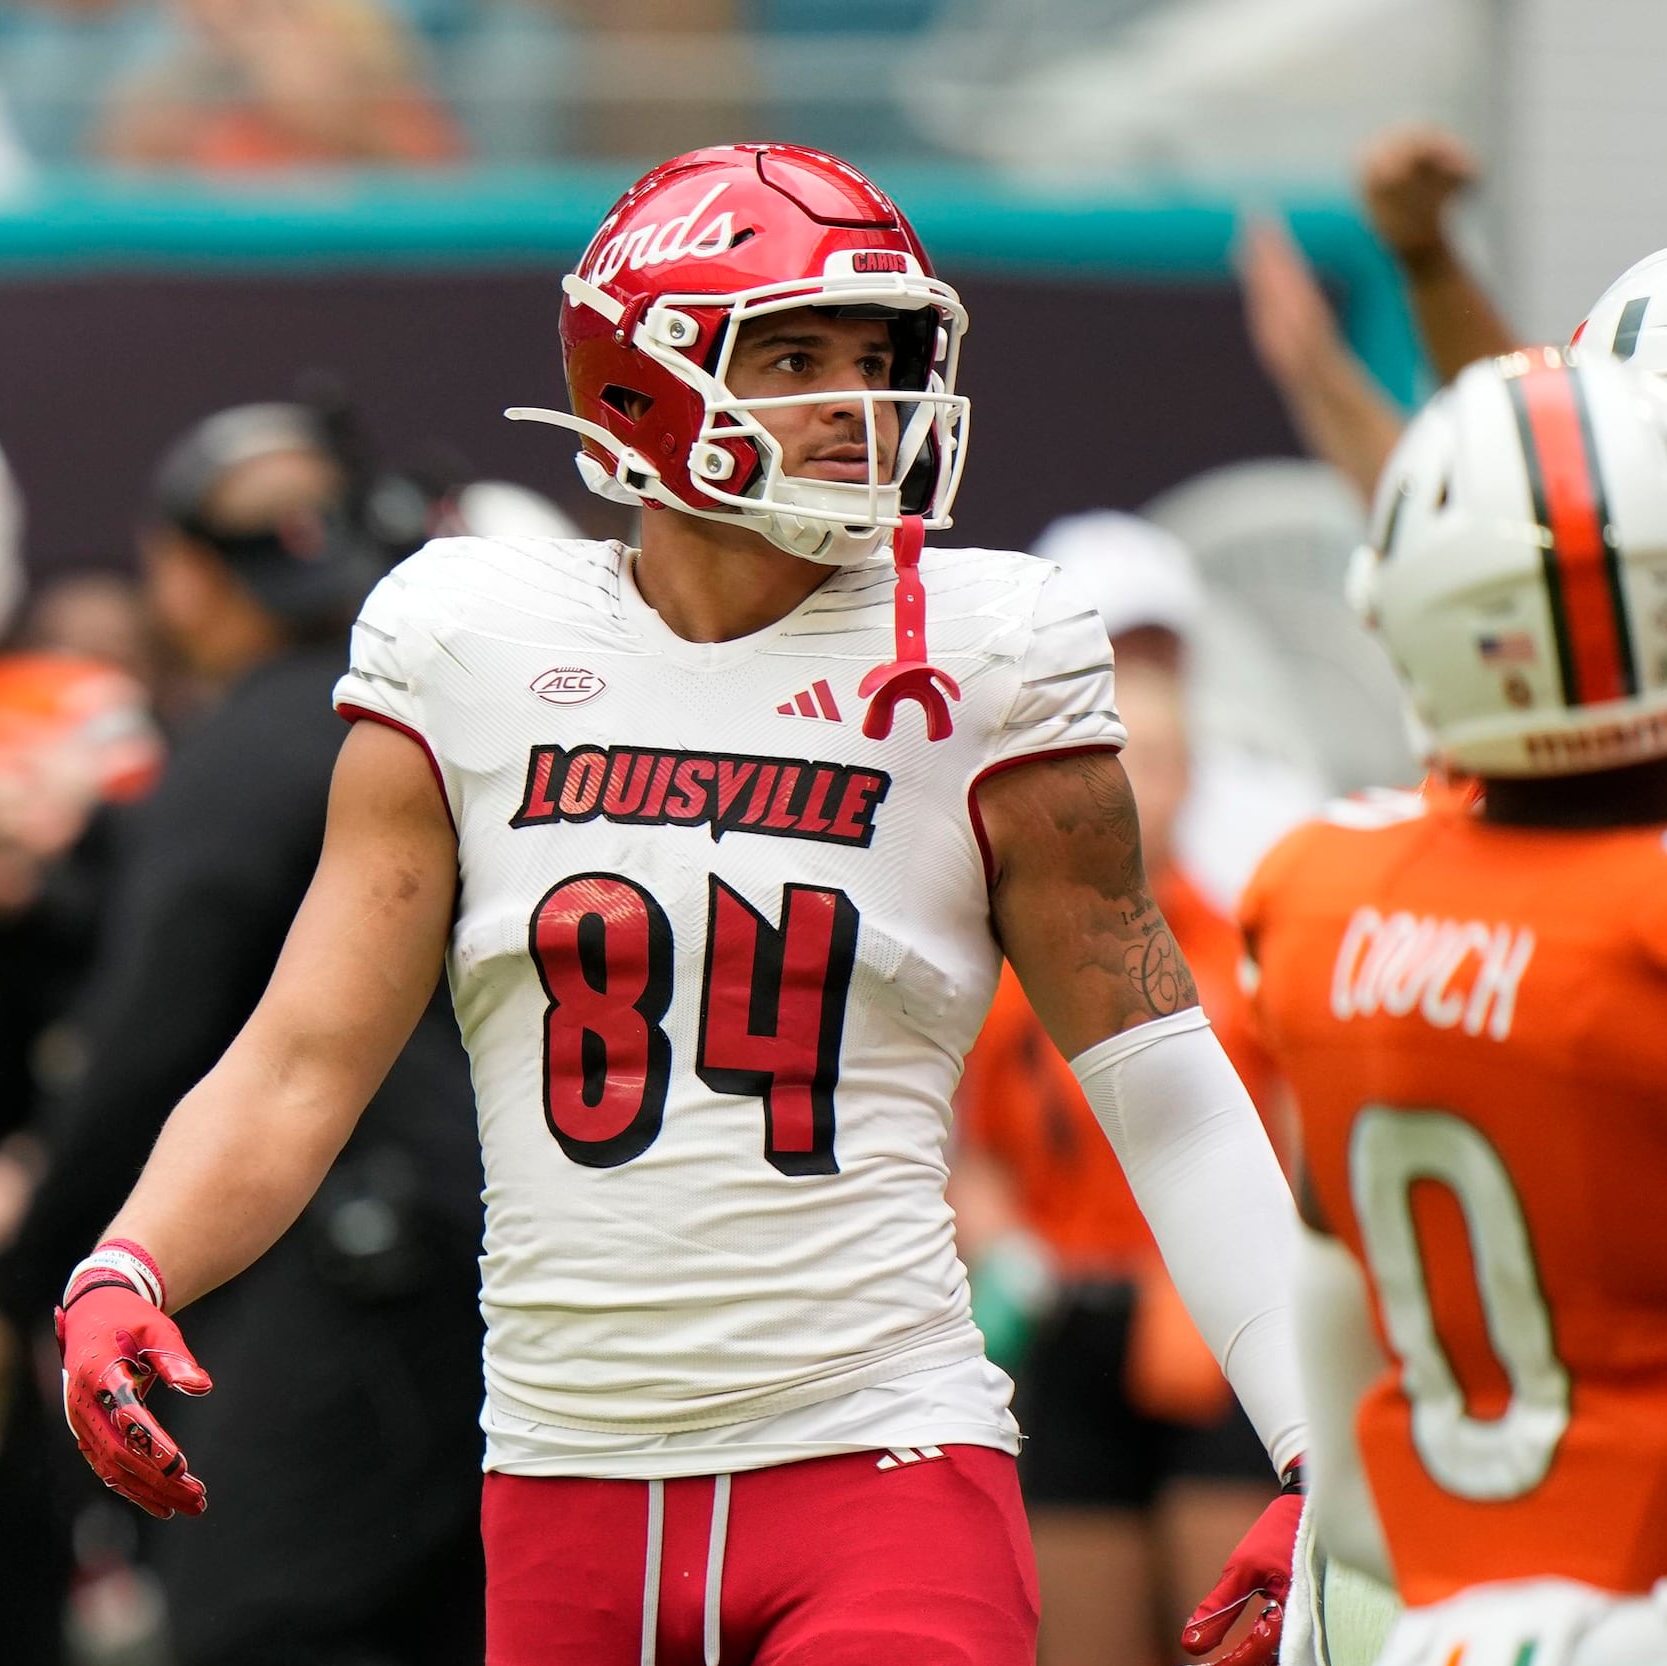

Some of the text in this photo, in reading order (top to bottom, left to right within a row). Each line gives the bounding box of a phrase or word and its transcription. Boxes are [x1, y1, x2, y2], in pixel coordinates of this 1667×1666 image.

[852, 252, 907, 273] CARDS
[539, 675, 593, 692] ACC
[509, 744, 892, 849] LOUISVILLE
[528, 871, 860, 1176] 84
[1349, 1104, 1570, 1502] 0
